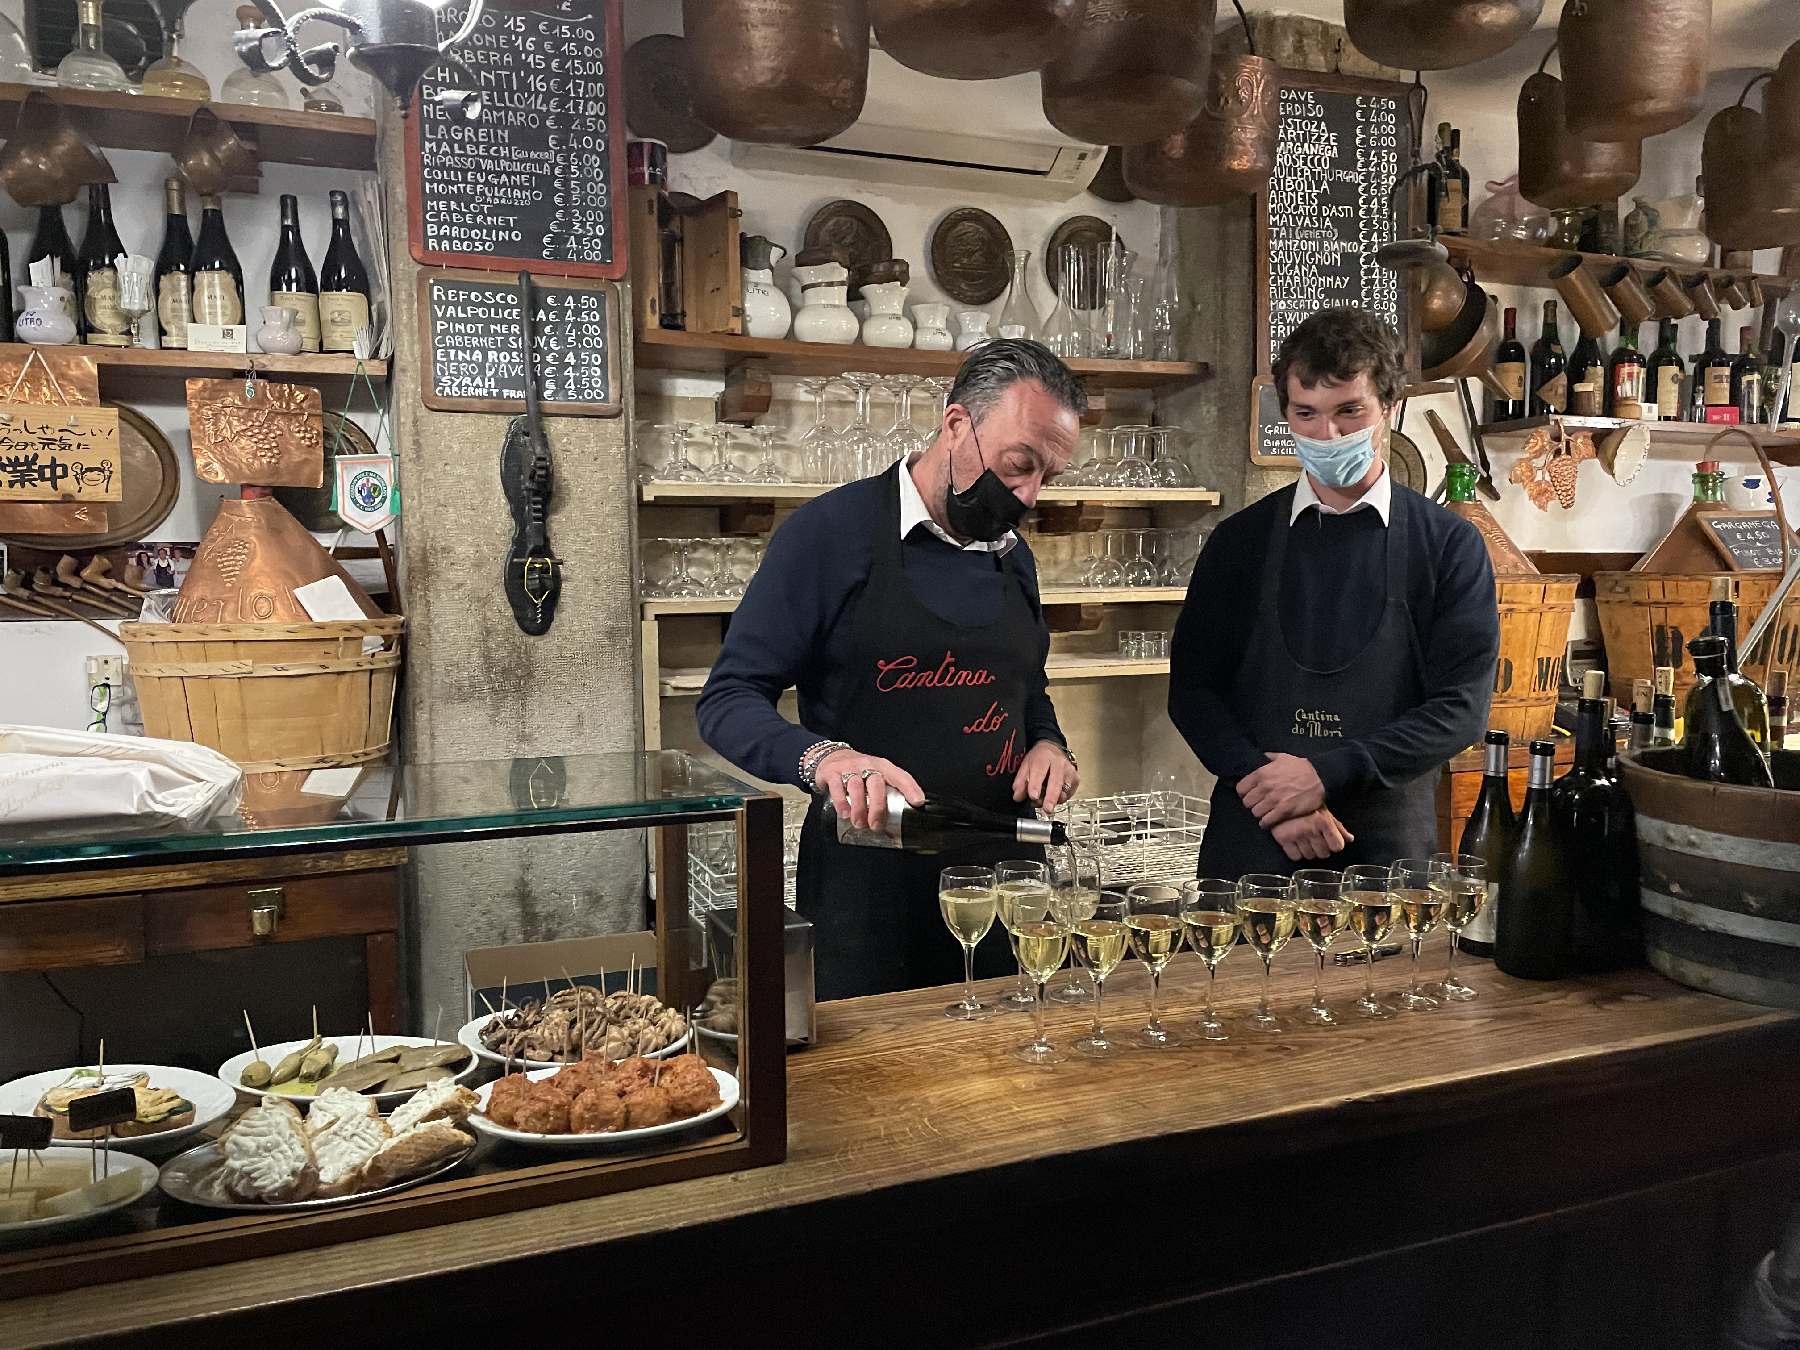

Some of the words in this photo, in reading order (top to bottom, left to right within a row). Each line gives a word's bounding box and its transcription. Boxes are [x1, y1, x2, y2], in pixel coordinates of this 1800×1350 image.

[425, 124, 509, 143] LAGREIN
[425, 141, 509, 157] MALBECH
[424, 154, 475, 169] RIPASSO
[423, 168, 461, 182] COLLI
[467, 171, 536, 187] EUGANEI
[425, 181, 542, 200] MONTEPULCIANO
[1269, 177, 1330, 194] RIBOLLA
[1269, 190, 1318, 205] ARNEIS
[427, 200, 493, 214] MERLOT
[1269, 203, 1318, 215] MOSCATO
[1322, 204, 1353, 217] D'ASTI
[425, 212, 518, 227] CABERNET
[1269, 214, 1332, 229] MALVASIA
[427, 224, 522, 241] BARDOLINO
[1268, 227, 1293, 238] TAI
[428, 239, 494, 251] RABOSO
[1269, 239, 1319, 251] MANZONI
[1323, 240, 1358, 253] BIANCO
[1269, 250, 1340, 266] SAUVIGNON
[1269, 263, 1319, 277] LUGANA
[1269, 276, 1349, 288] CHARDONNAY
[433, 285, 518, 304] REFOSCO
[1269, 287, 1325, 299] RIESLING
[1270, 300, 1320, 311] MOSCATO
[436, 321, 484, 334] PINOT
[490, 324, 520, 334] NER
[434, 335, 504, 348] CABERNET
[436, 349, 482, 362] ETNA
[436, 362, 479, 375] NERO
[439, 375, 495, 388] SYRAH
[435, 387, 499, 397] CABERNET
[1712, 520, 1780, 530] GARGANEGA
[876, 651, 996, 692] Cantina
[1295, 708, 1341, 722] Cantina
[1291, 724, 1305, 735] do
[1307, 721, 1343, 737] Mori
